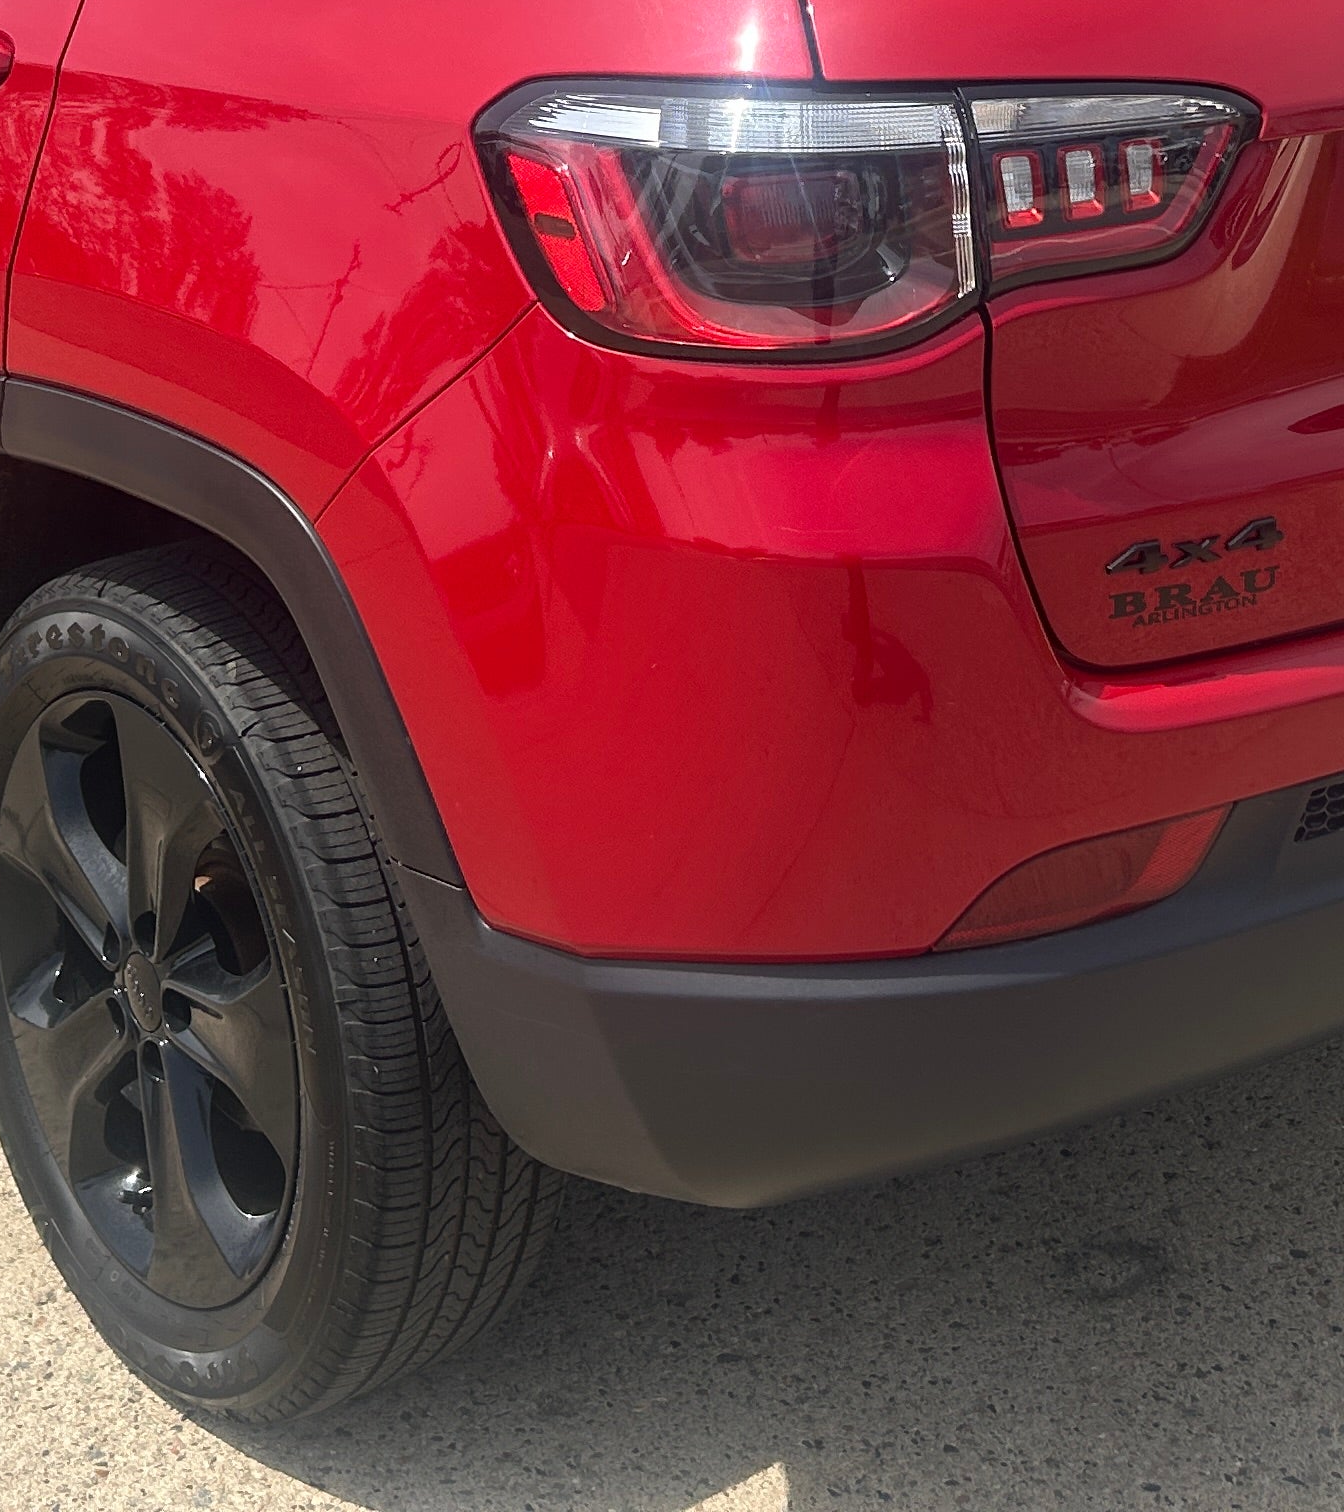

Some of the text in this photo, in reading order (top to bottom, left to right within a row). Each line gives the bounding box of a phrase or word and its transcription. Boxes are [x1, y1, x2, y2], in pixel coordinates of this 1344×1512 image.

[1105, 516, 1284, 575] 4x4
[1109, 565, 1280, 619] BRAU
[1132, 594, 1257, 628] ARLINGTON
